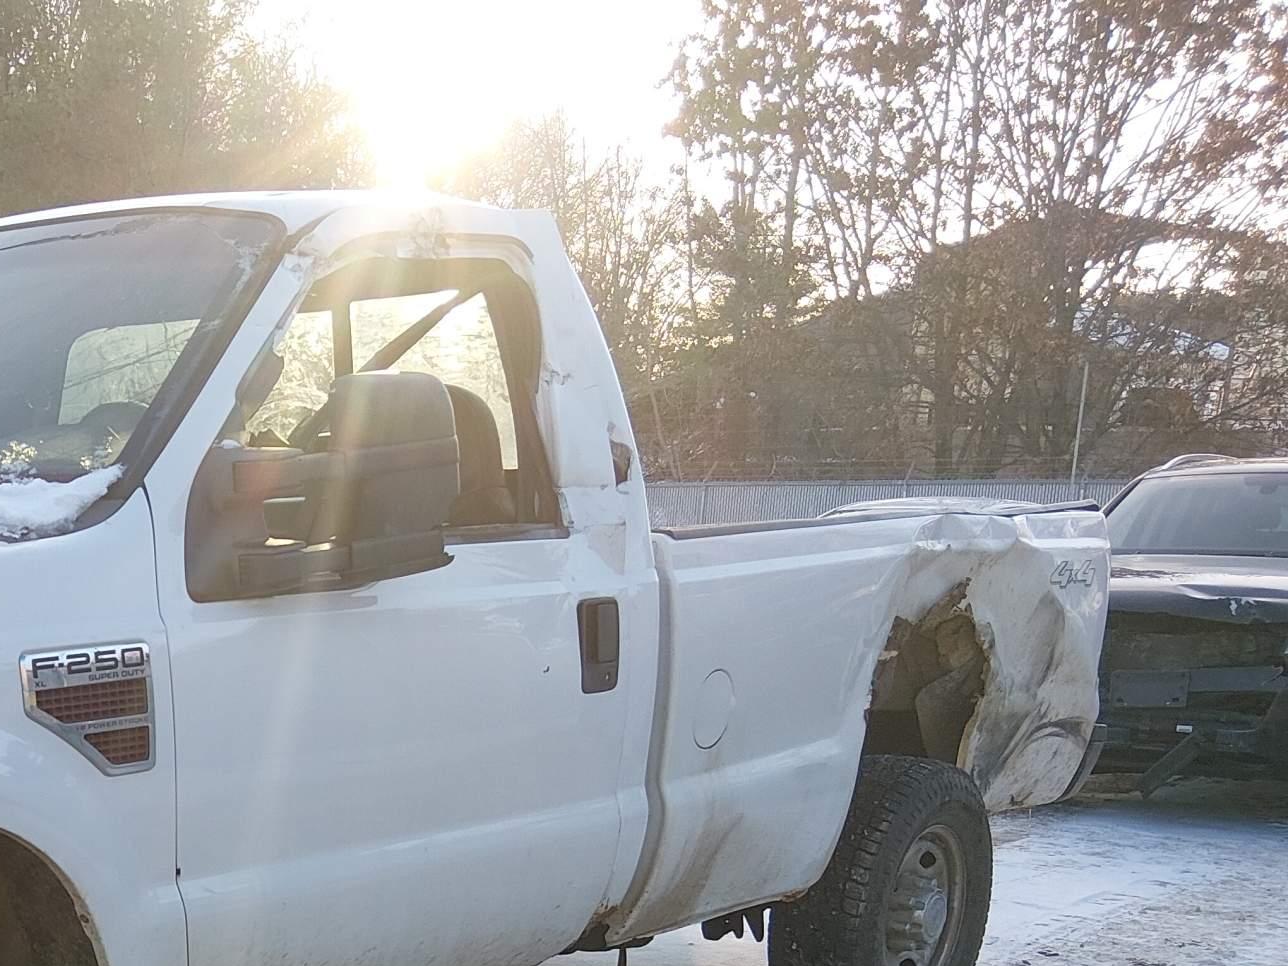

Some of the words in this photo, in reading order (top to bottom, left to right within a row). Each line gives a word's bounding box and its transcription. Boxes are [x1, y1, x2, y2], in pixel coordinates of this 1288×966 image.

[1050, 560, 1096, 589] 4x4
[32, 647, 145, 679] F-250
[88, 671, 119, 681] SUPER
[121, 669, 145, 678] DUTY
[87, 720, 118, 730] POWER
